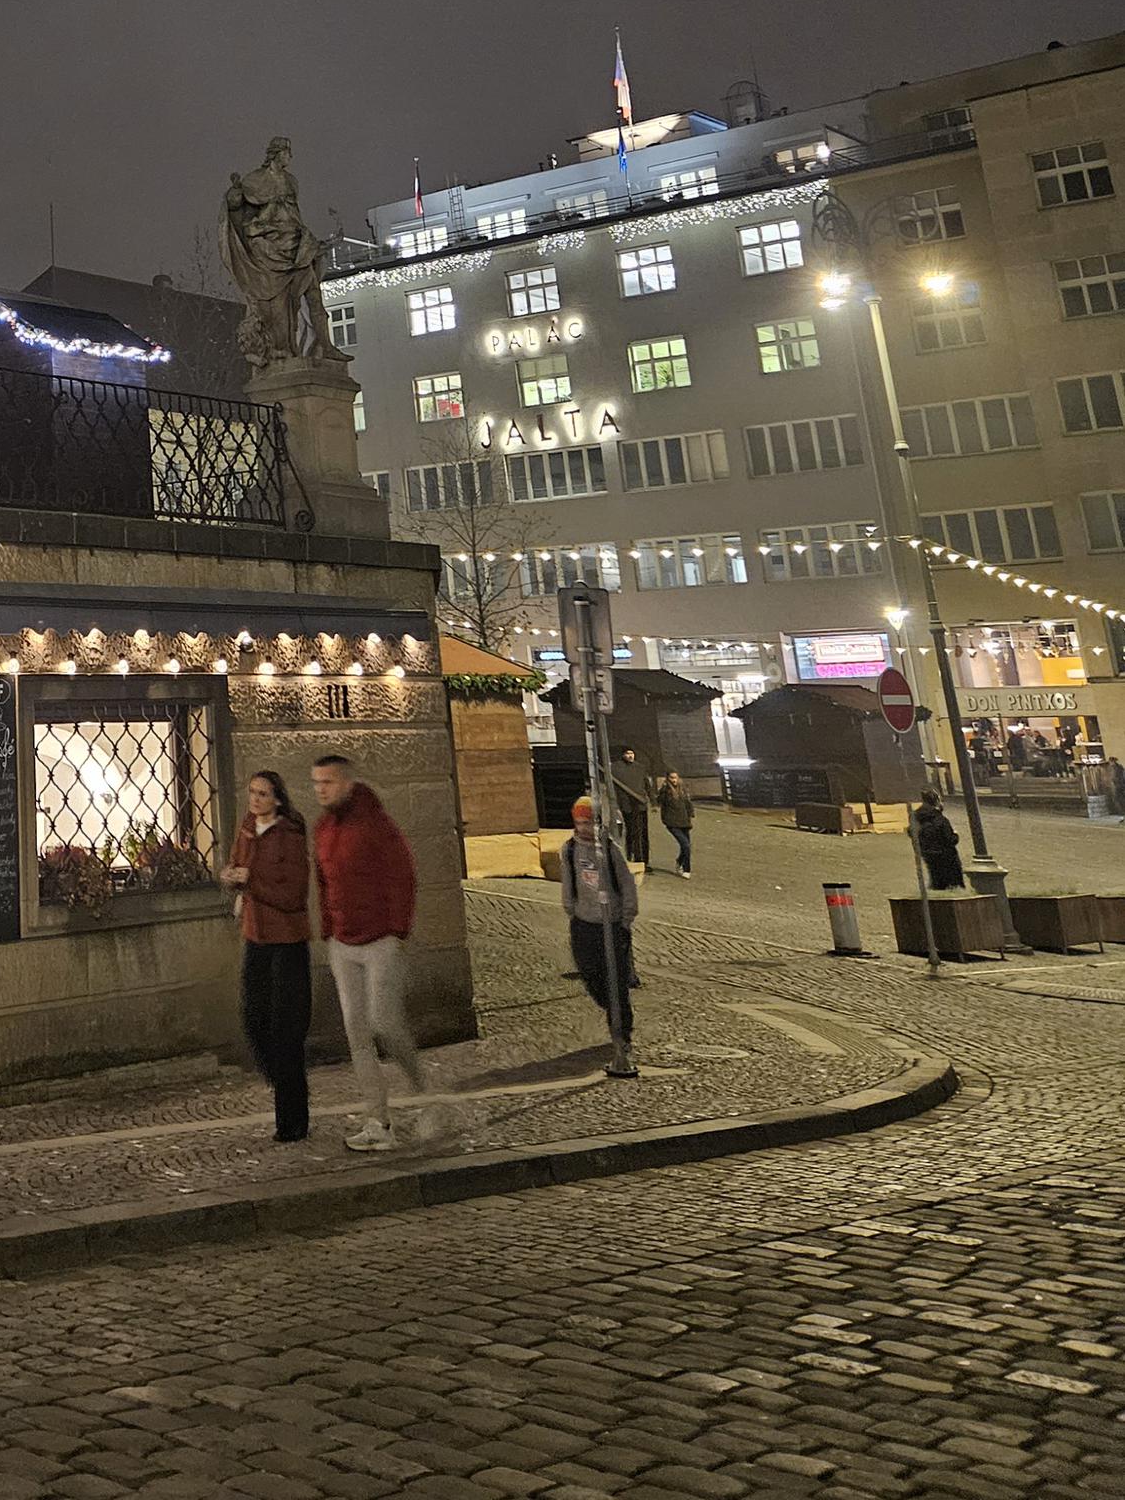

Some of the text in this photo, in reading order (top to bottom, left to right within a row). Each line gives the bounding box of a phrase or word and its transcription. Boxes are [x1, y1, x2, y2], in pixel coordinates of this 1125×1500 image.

[491, 317, 582, 352] PALÁC
[480, 409, 621, 449] JALTA
[965, 691, 1078, 712] DON PINTXOS
